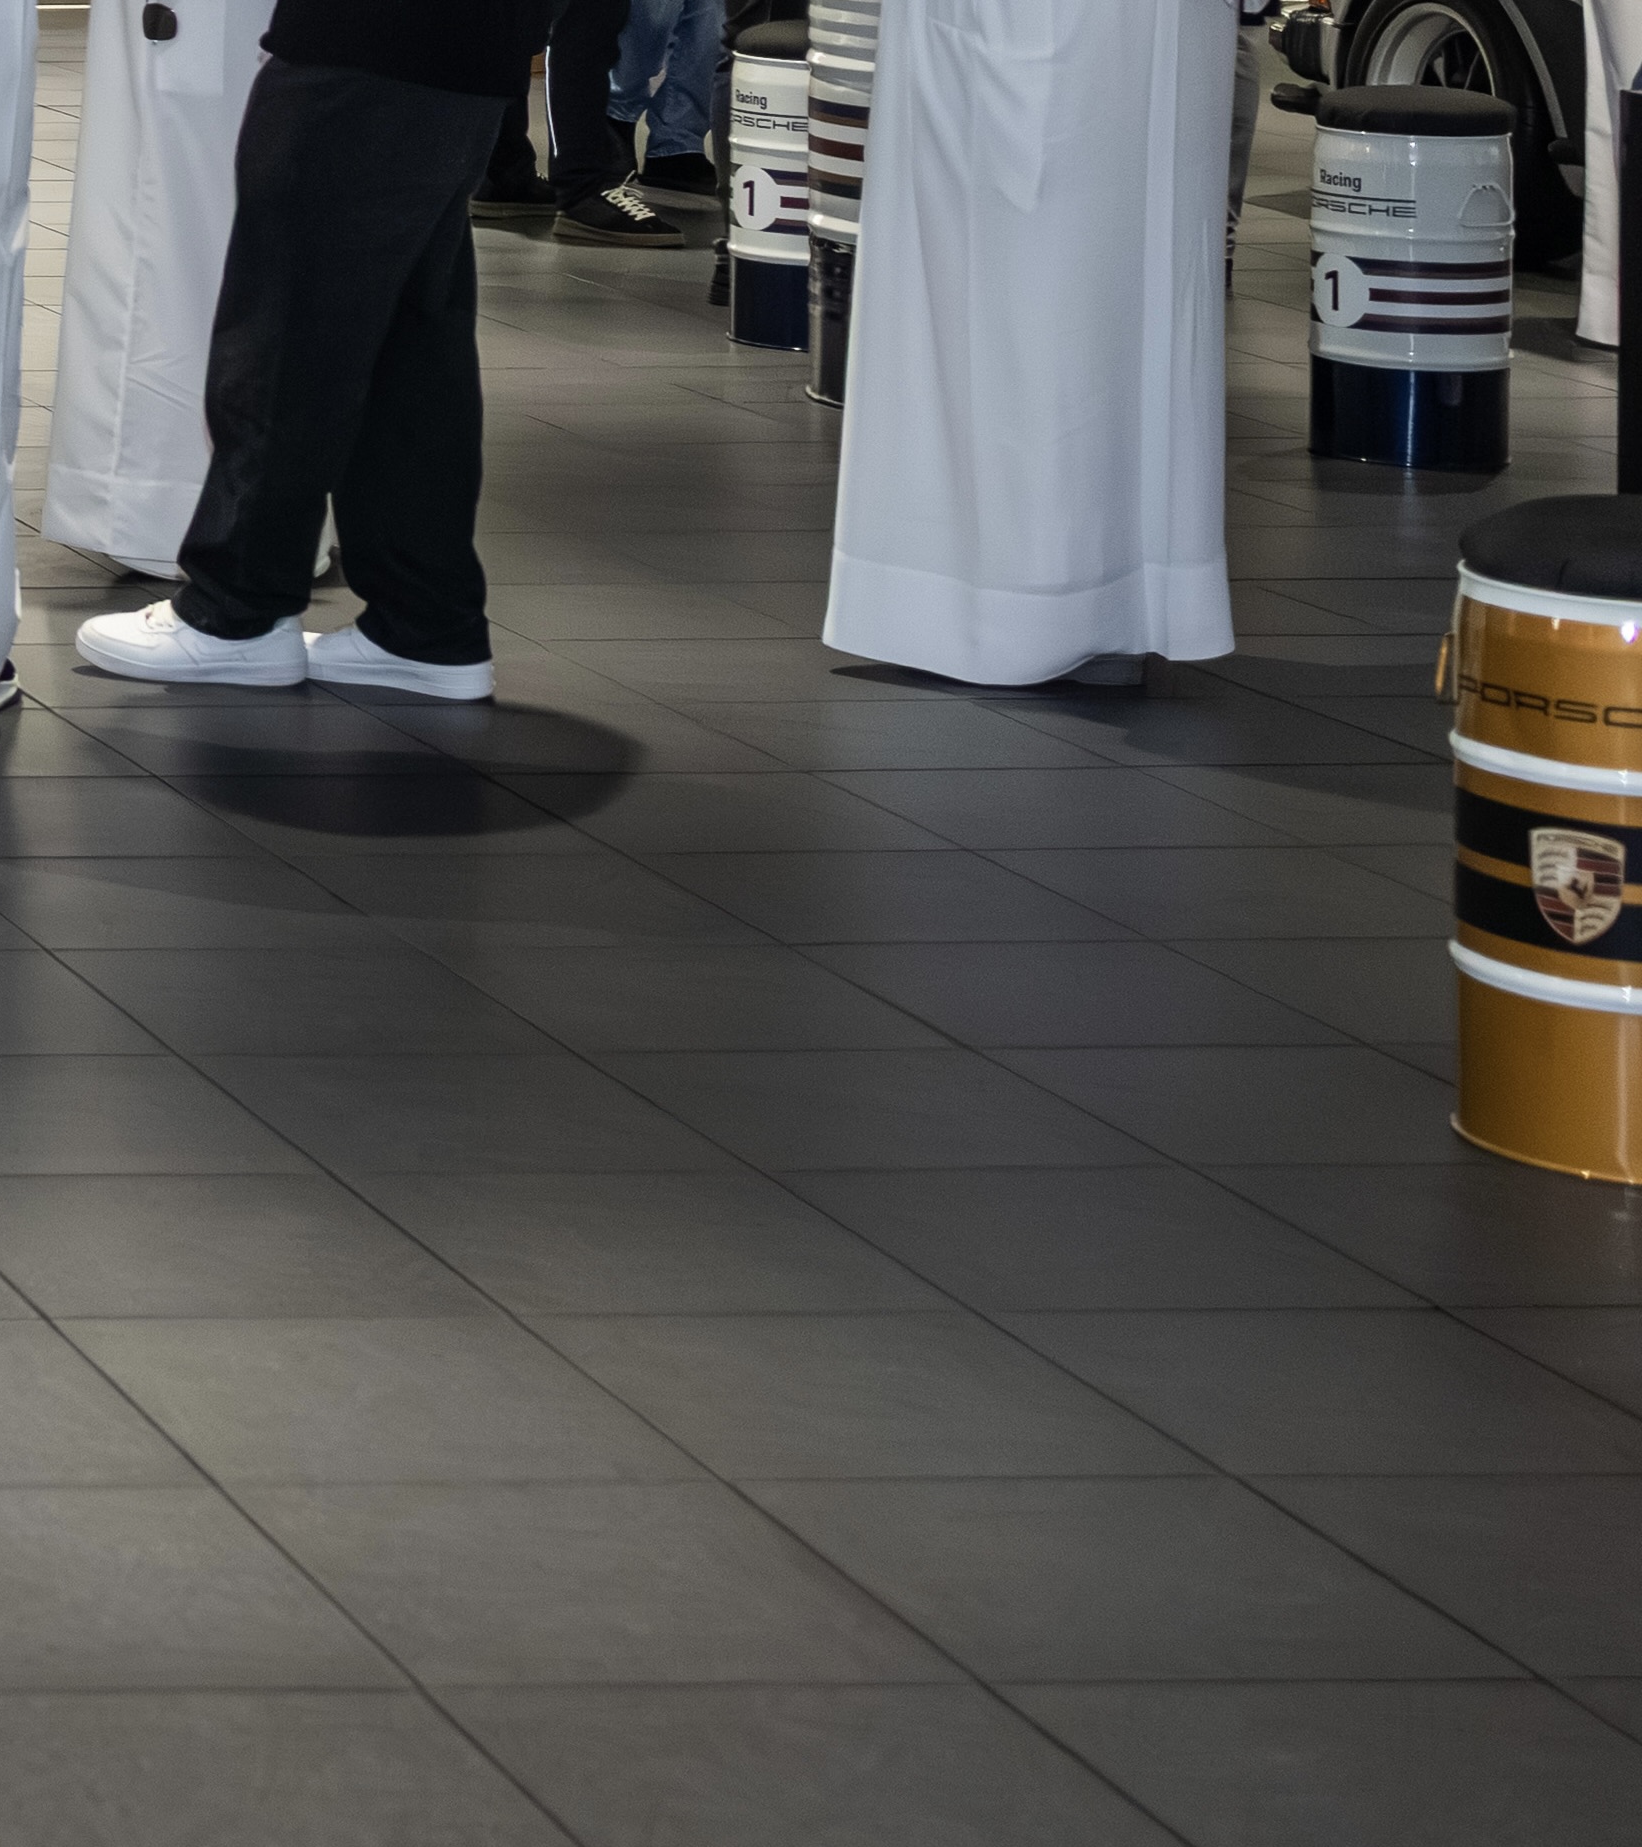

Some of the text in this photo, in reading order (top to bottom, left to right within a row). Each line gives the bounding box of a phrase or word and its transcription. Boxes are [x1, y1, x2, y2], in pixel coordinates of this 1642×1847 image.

[735, 88, 767, 110] Racing
[730, 113, 809, 133] RSCHE
[1319, 168, 1362, 193] Racing
[742, 180, 756, 216] 1
[1312, 195, 1417, 218] RSCHE
[1324, 269, 1339, 312] 1
